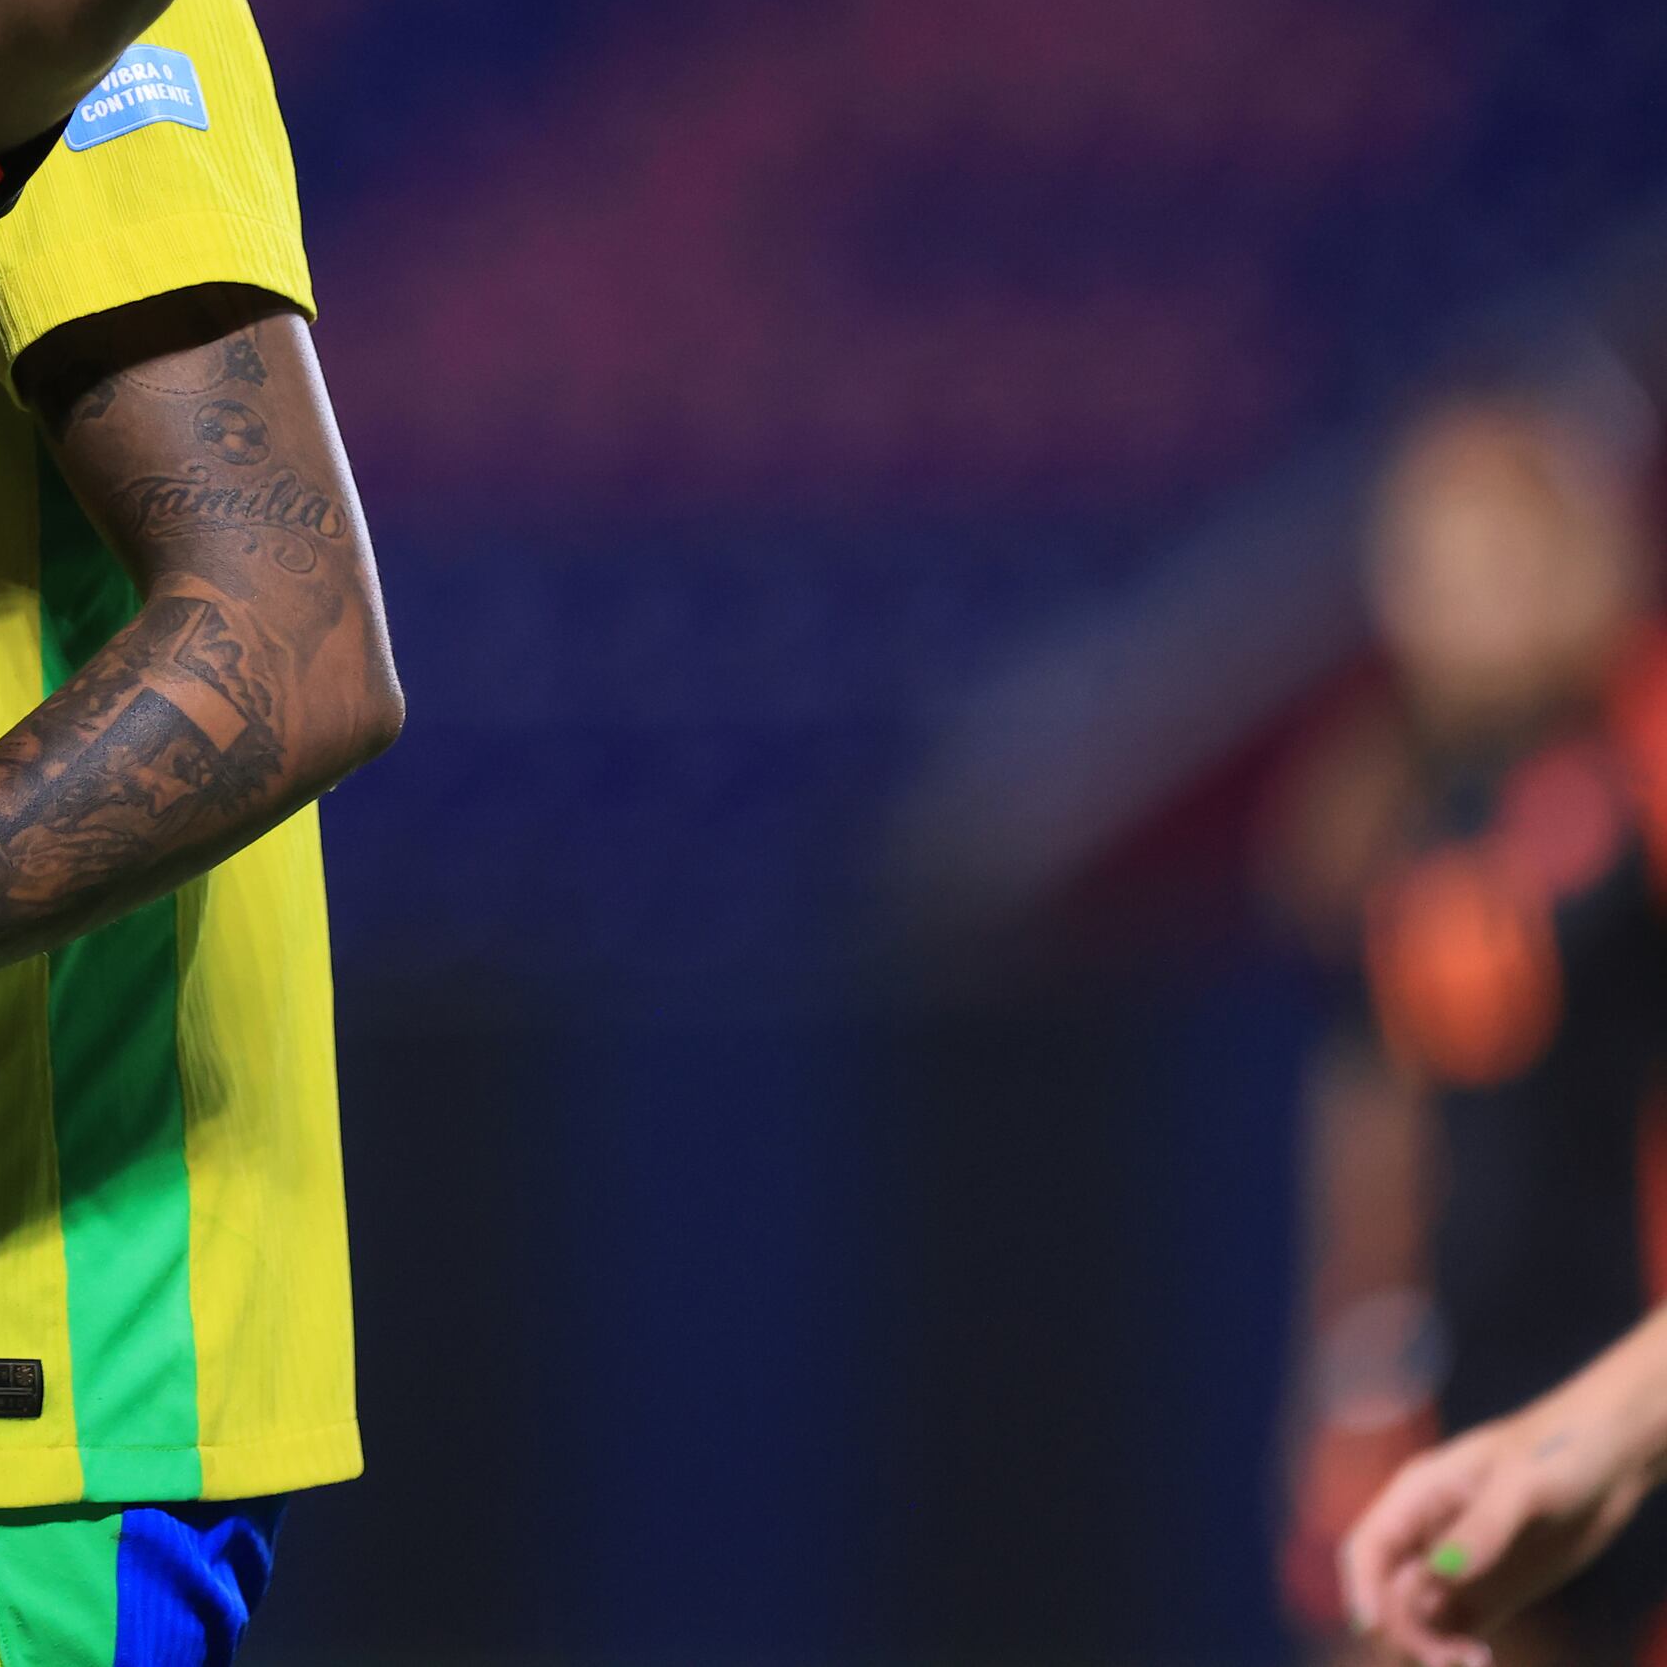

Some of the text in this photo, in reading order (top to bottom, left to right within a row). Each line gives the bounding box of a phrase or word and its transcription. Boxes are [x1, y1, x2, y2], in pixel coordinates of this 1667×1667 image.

[99, 61, 173, 92] VIBRA O
[80, 82, 194, 122] CONTINENTE
